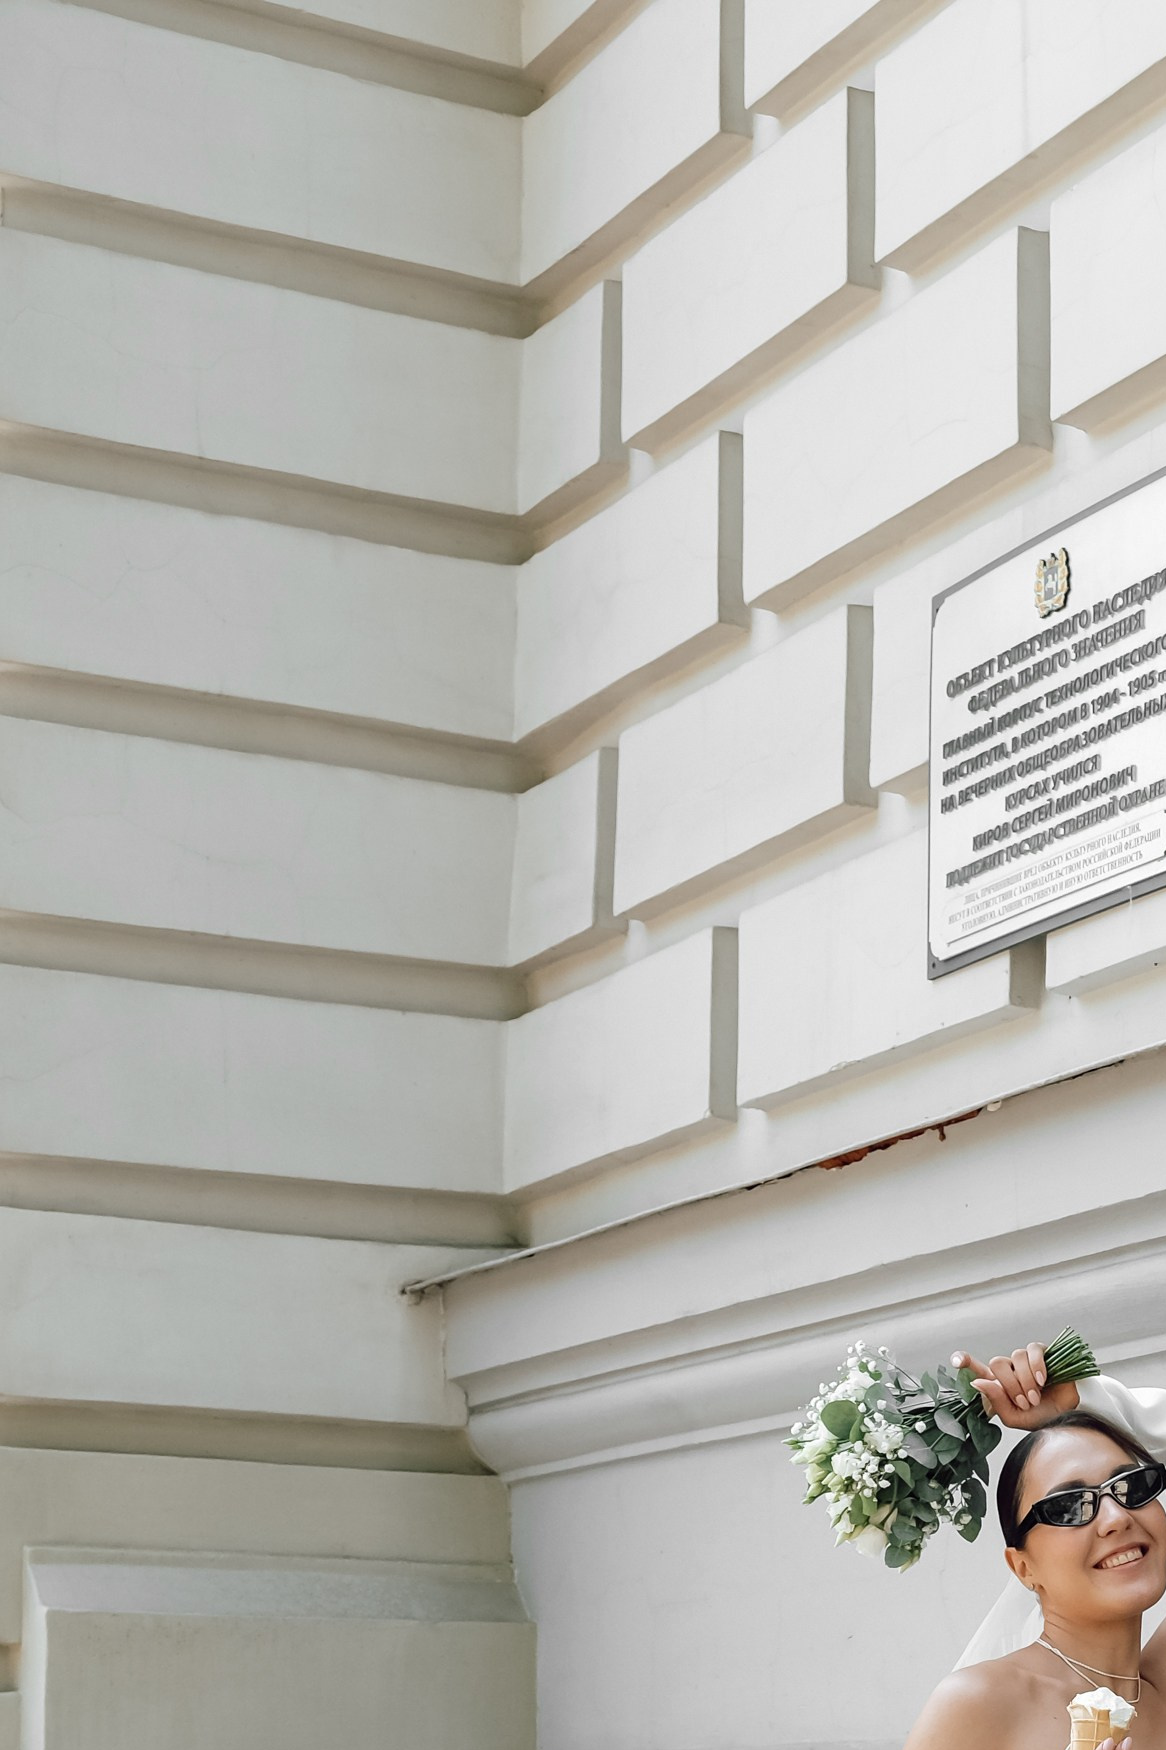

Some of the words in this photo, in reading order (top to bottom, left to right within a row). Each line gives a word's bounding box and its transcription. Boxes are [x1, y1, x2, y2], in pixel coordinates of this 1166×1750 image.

[947, 658, 995, 699] ОБЪЕКТ
[997, 609, 1091, 673] КУЛЬТУРНОГО
[968, 648, 1070, 714] ФЕДЕРАЛЬНОГО
[1071, 609, 1145, 662] ЗНАЧЕНИЯ
[943, 716, 997, 759] ГЛАВНЫЙ
[997, 696, 1044, 733] КОРПУС
[943, 742, 1011, 787] ИНСТИТУТА,
[1012, 736, 1020, 753] В
[1021, 706, 1080, 748] КОТОРОМ
[1081, 703, 1090, 721] В
[941, 794, 958, 814] НА
[958, 765, 1016, 806] ВЕЧЕРНИХ
[973, 822, 1011, 852] КИРОВ
[1012, 798, 1055, 833] СЕРГЕЙ
[1056, 765, 1137, 814] МИРОНОВИЧ
[1005, 777, 1051, 812] КУРСАХ
[1052, 754, 1101, 790] УЧИЛСЯ
[946, 849, 1005, 889] ПОДЛЕЖИТ
[1006, 796, 1118, 863] ГОСУДАРСТВЕННОЙ
